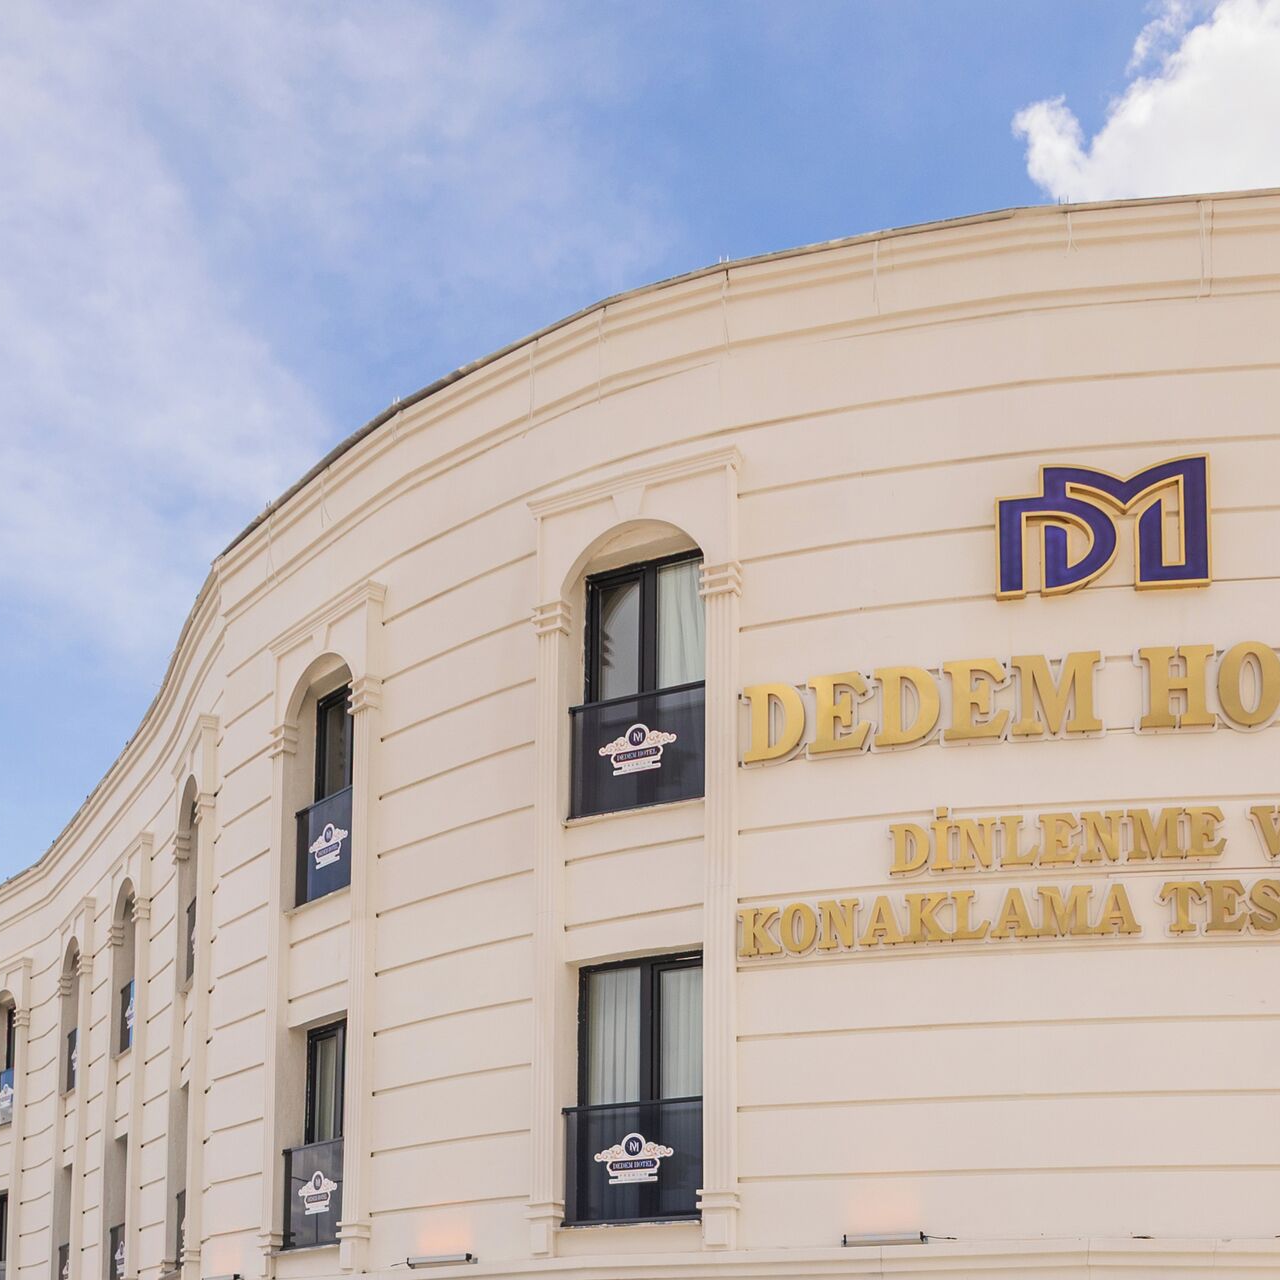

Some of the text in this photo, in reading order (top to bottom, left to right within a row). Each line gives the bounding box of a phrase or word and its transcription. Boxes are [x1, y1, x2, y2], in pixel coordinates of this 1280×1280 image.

[741, 650, 1104, 767] DEDEM
[888, 806, 1228, 875] DİNLENME
[737, 882, 1142, 958] KONAKLAMA
